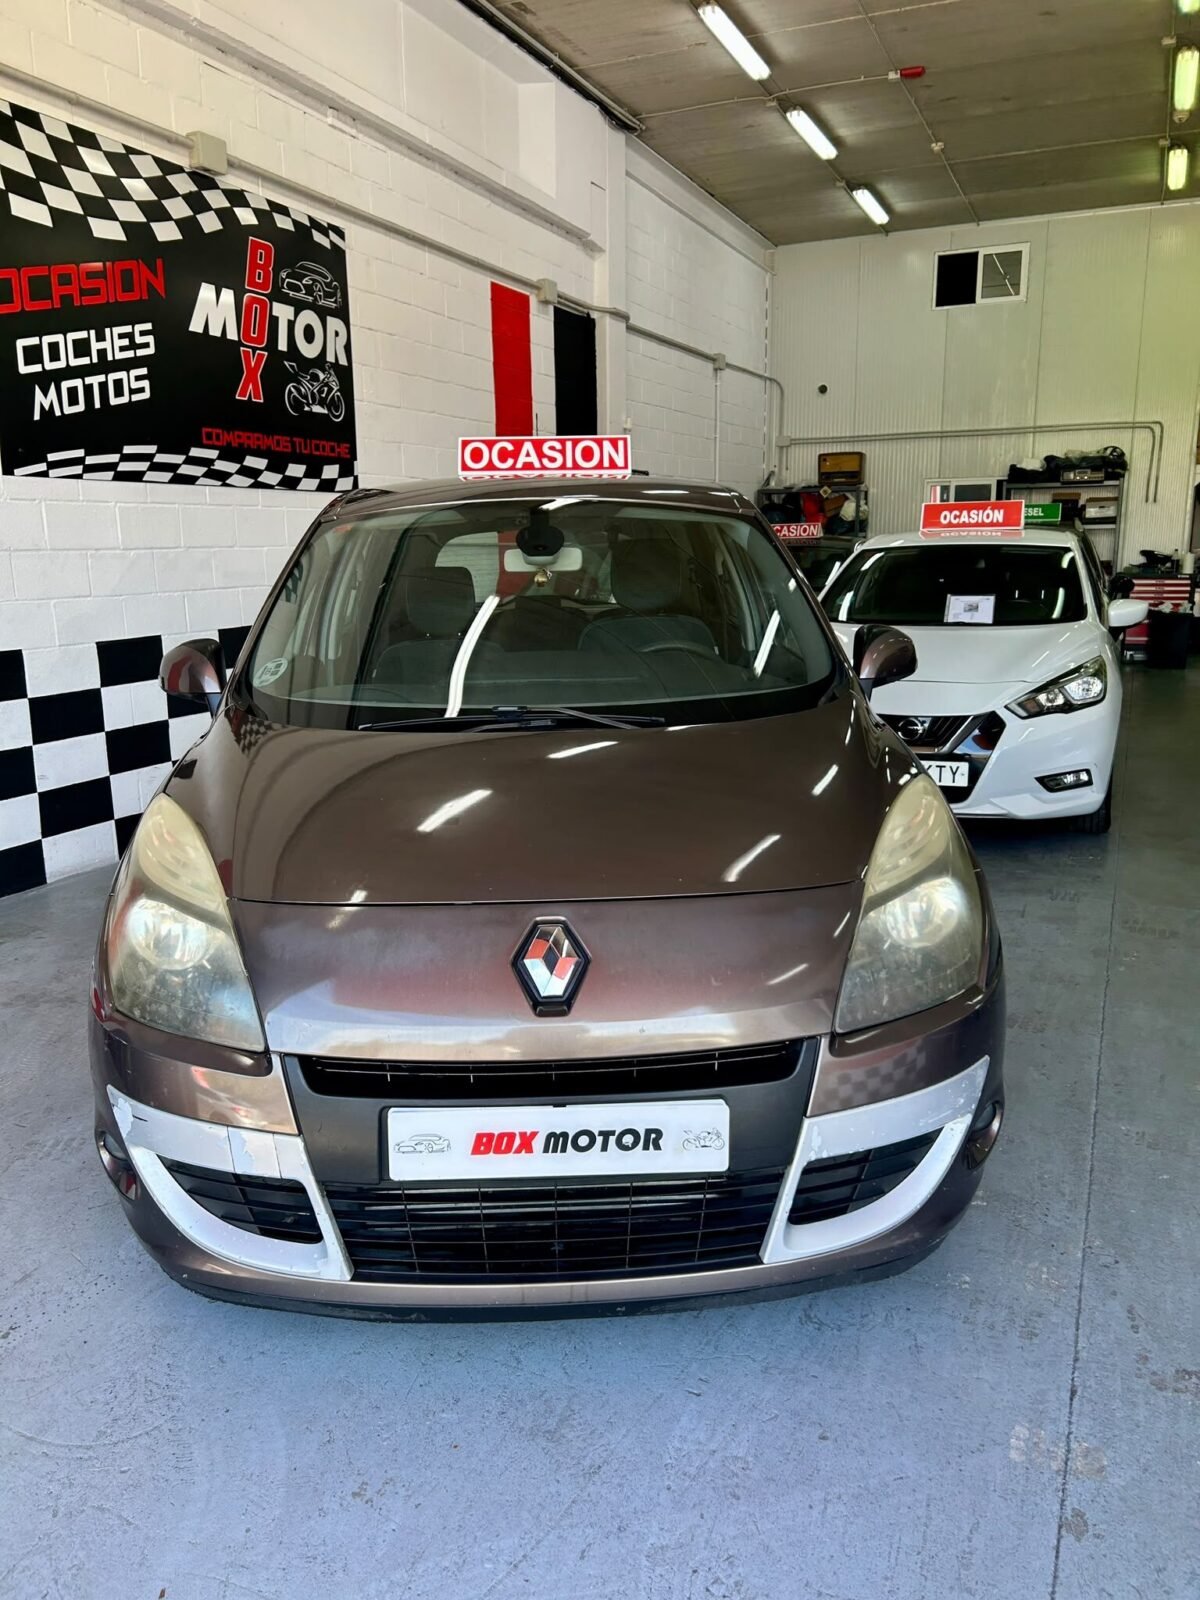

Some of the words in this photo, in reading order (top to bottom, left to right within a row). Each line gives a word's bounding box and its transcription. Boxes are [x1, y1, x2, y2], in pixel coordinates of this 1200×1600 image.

[235, 236, 275, 403] BOX
[16, 322, 156, 375] COCHES
[33, 367, 151, 421] MOTOS
[202, 427, 292, 453] COMPRAMOS
[293, 437, 310, 454] TU
[311, 440, 351, 458] COCHE
[463, 439, 625, 470] OCASION
[940, 506, 1004, 524] OCASIÓN
[471, 1130, 539, 1156] BOX
[542, 1127, 664, 1154] MOTOR
